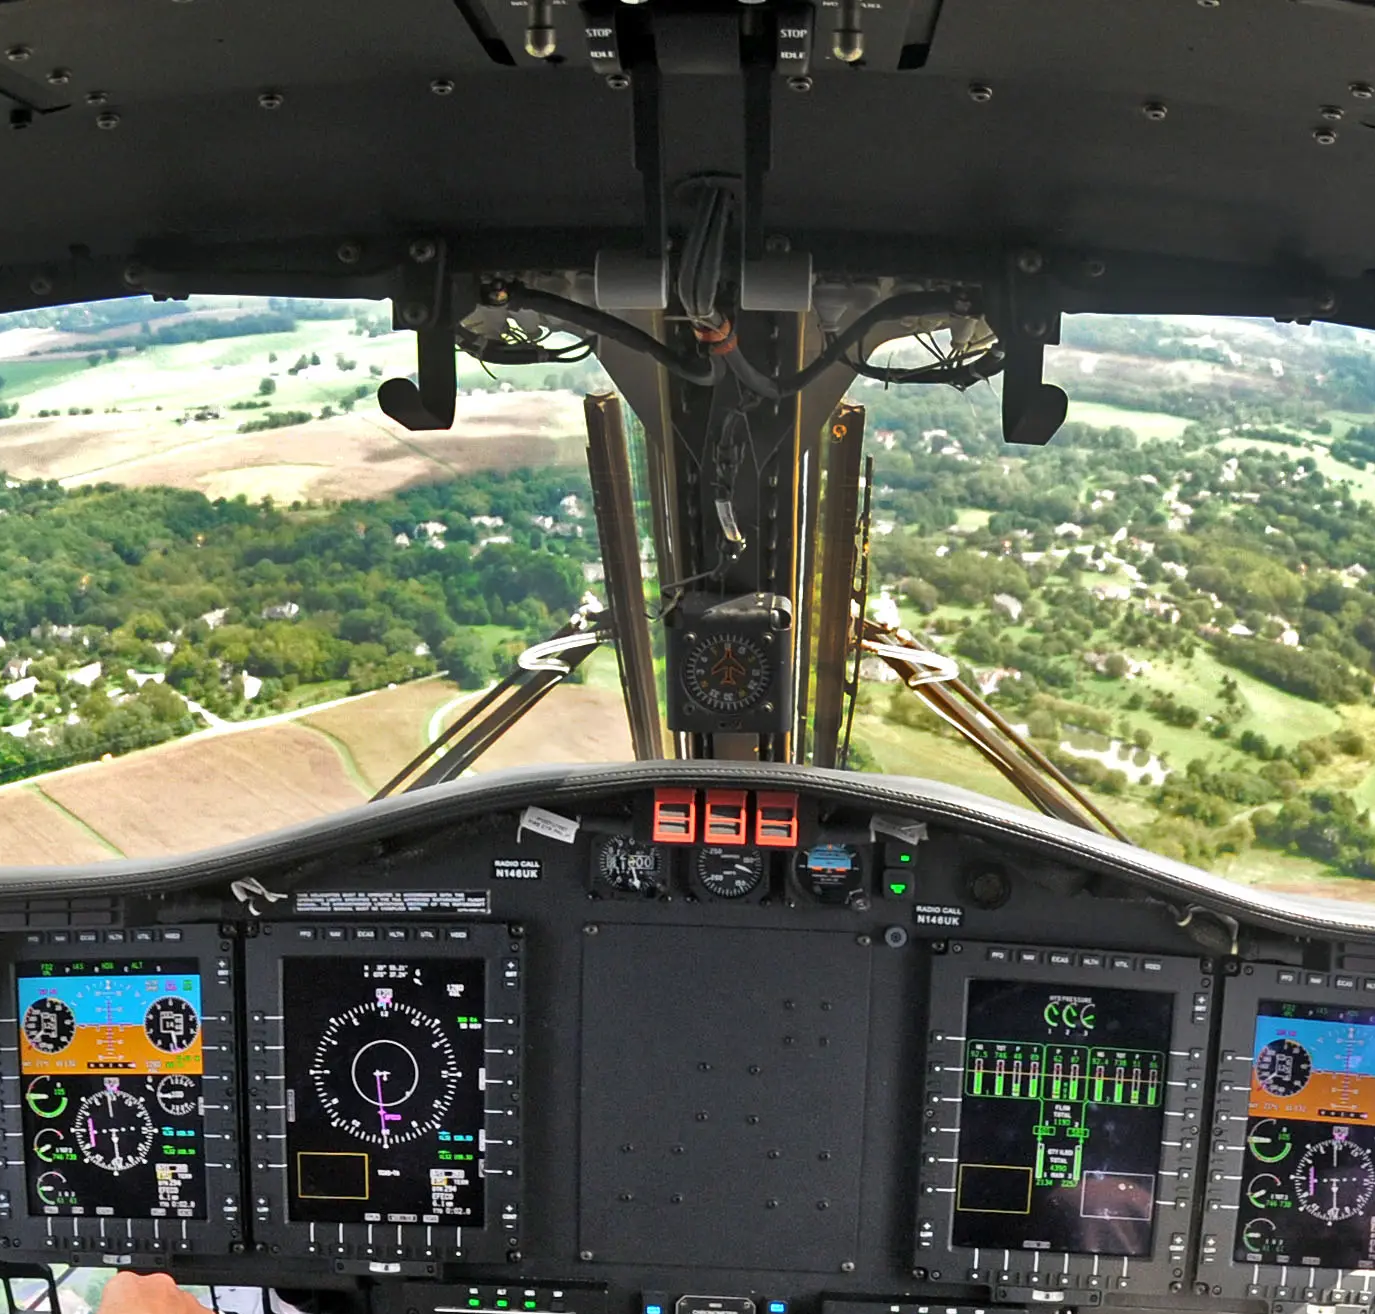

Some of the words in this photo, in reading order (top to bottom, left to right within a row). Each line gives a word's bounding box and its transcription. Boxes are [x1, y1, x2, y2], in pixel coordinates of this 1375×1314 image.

[585, 28, 612, 38] STOP
[780, 29, 808, 38] STOP
[590, 51, 615, 59] IDLE
[781, 52, 805, 60] IDLE
[520, 860, 540, 868] CALL
[916, 905, 941, 914] RADIO
[942, 907, 963, 915] CALL
